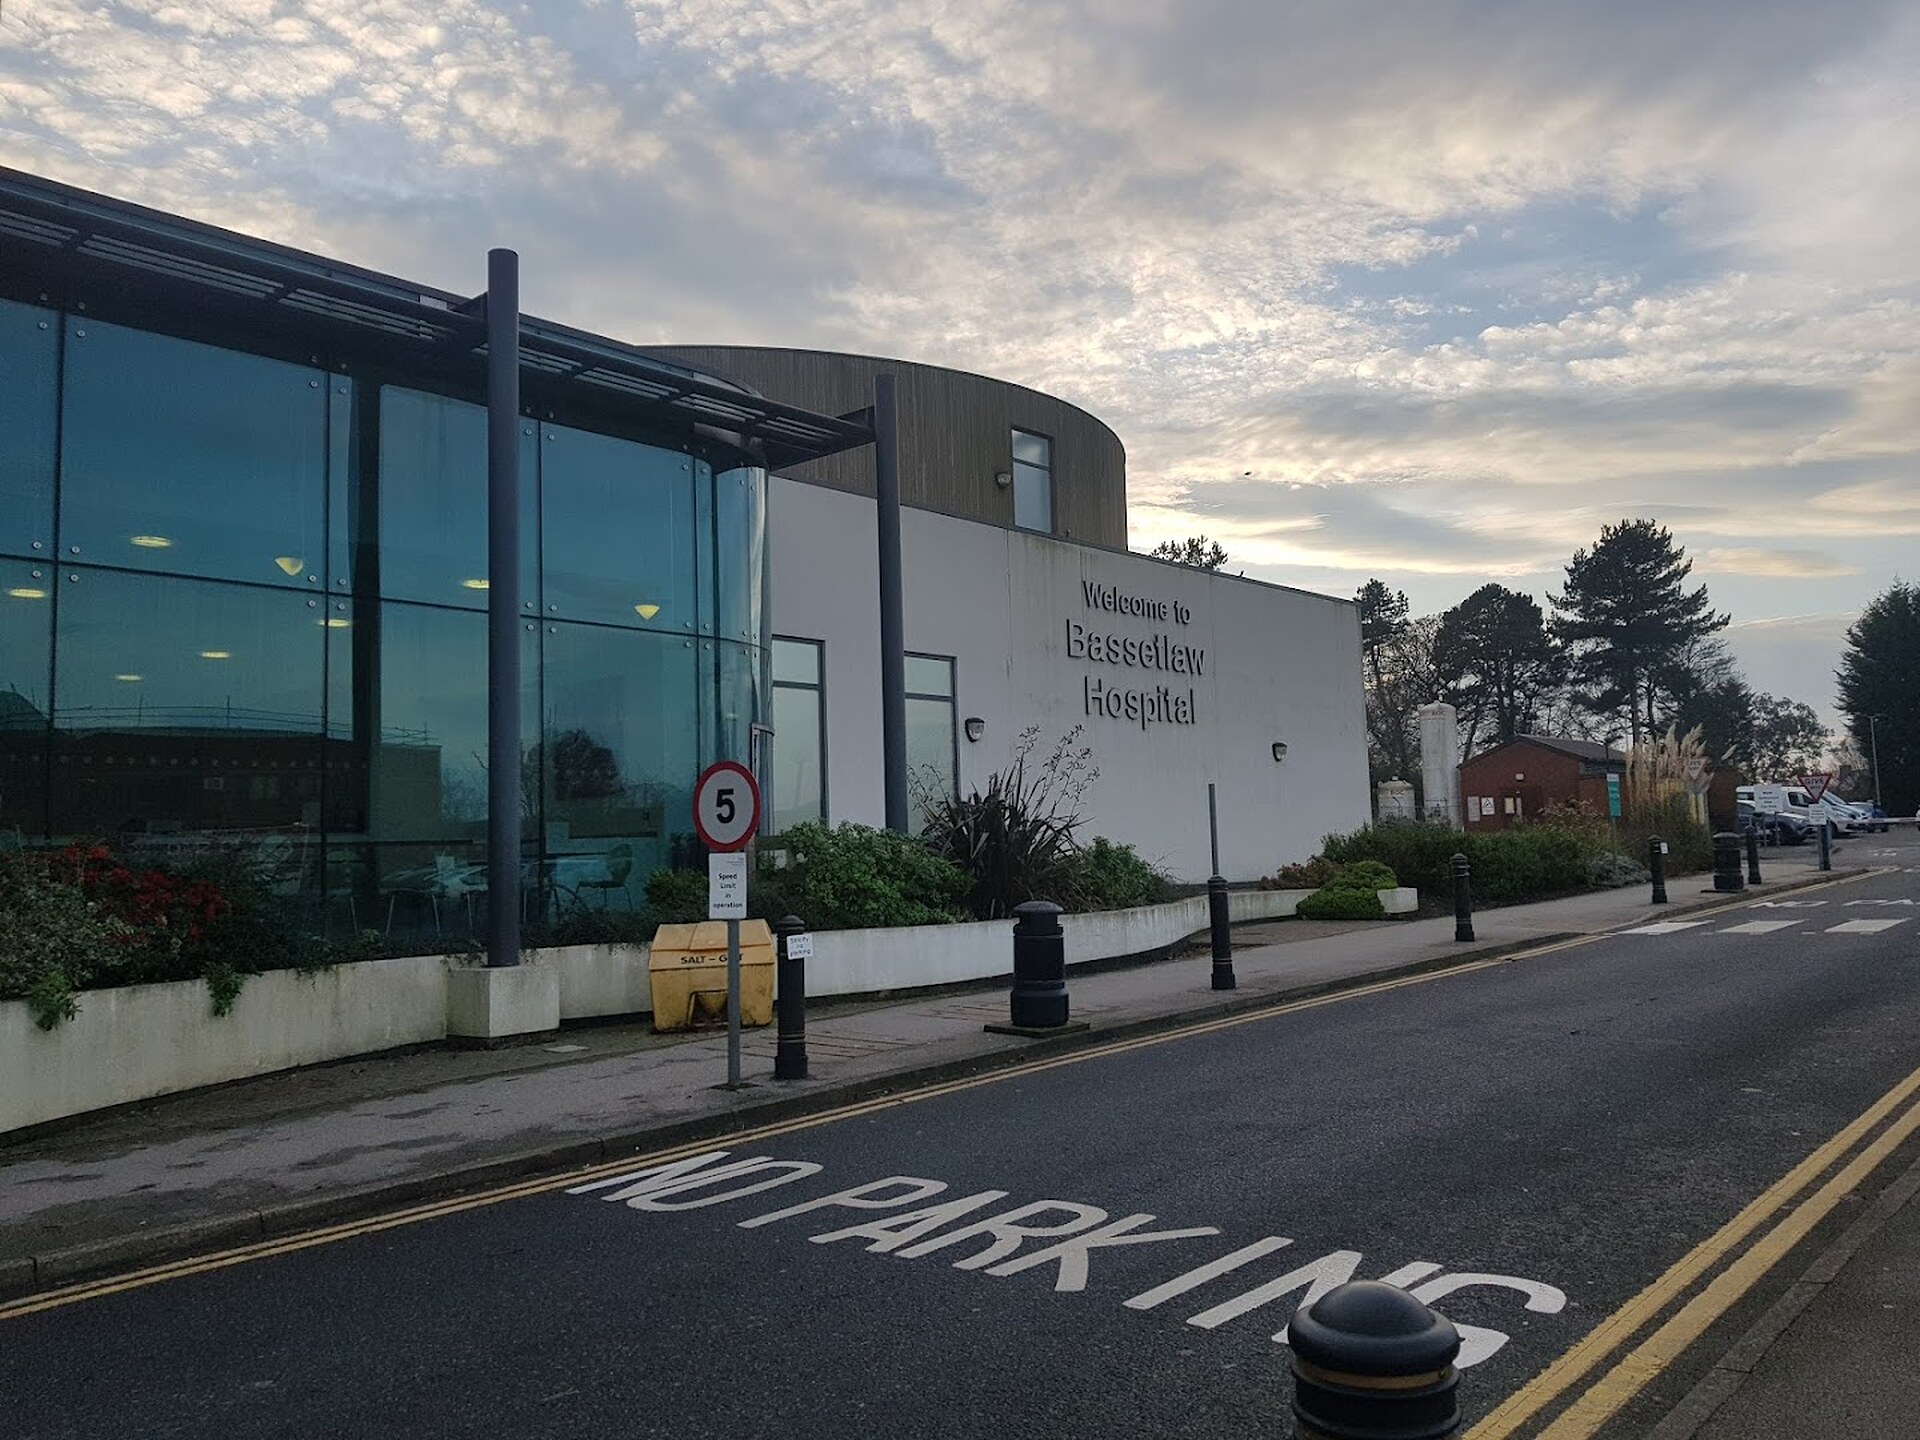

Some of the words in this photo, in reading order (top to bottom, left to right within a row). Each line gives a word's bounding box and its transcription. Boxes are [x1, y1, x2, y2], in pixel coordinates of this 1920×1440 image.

[1082, 580, 1168, 621] Welcome
[1173, 600, 1191, 625] to
[1066, 618, 1205, 676] Bassetlaw
[1084, 675, 1196, 730] Hospital
[715, 788, 736, 825] 5
[718, 872, 738, 881] Speed
[680, 955, 706, 964] SALT
[718, 953, 744, 963] GT
[565, 1151, 824, 1213] NO
